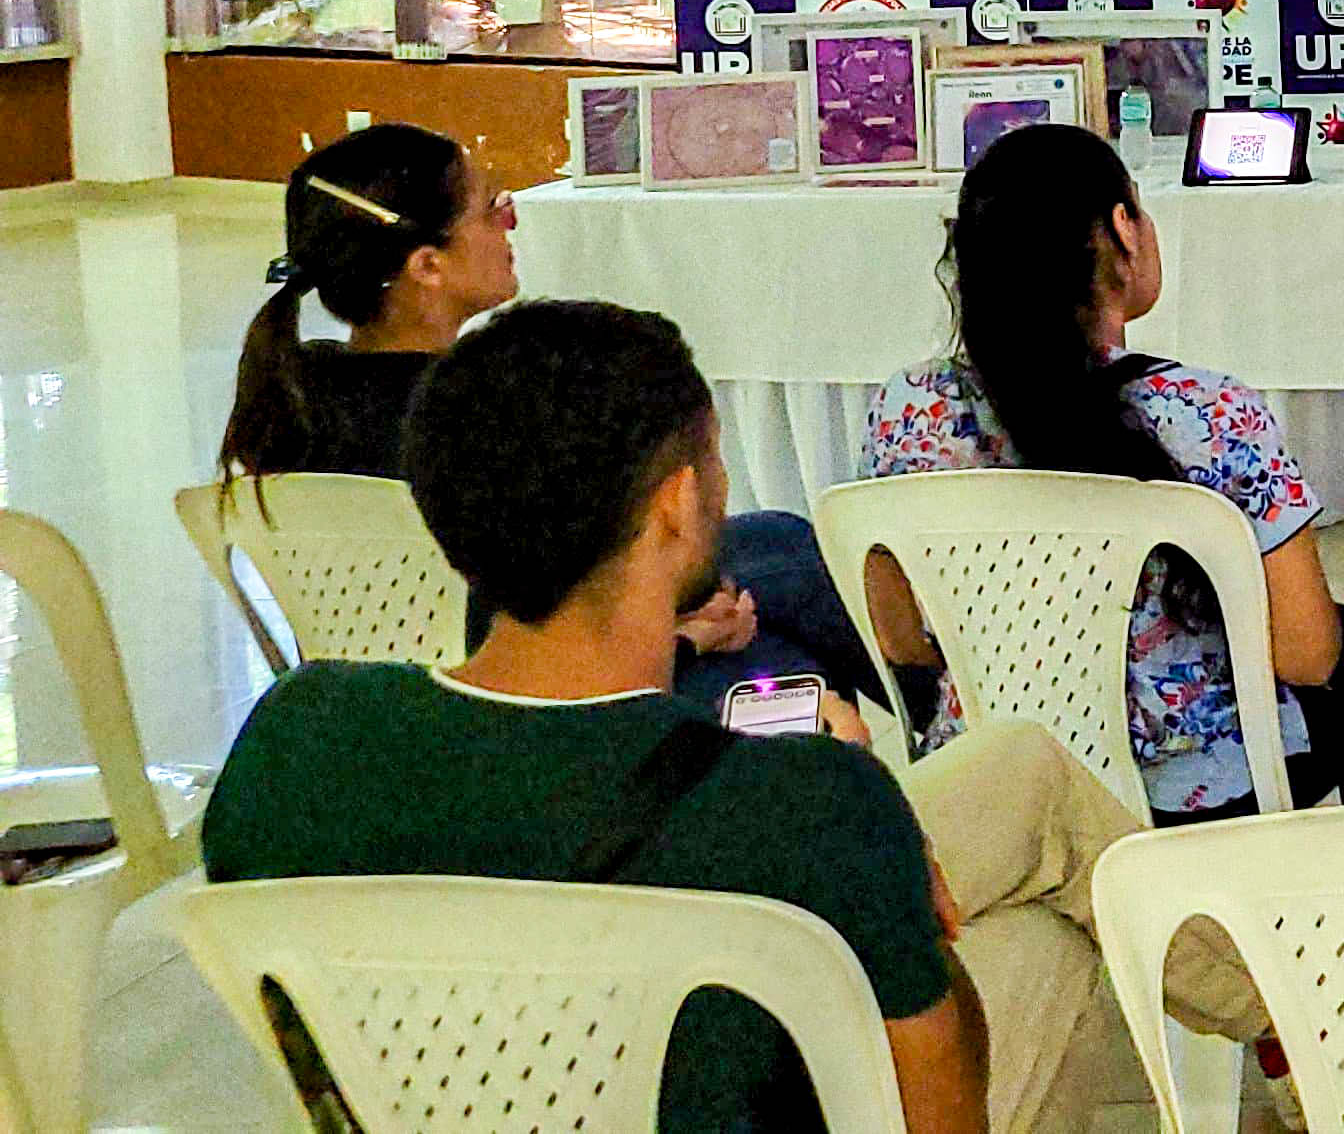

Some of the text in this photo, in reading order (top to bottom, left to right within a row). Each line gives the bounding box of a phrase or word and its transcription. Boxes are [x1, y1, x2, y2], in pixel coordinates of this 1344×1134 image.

[1235, 38, 1251, 46] LA
[1223, 46, 1251, 56] DAD
[681, 51, 750, 75] UP
